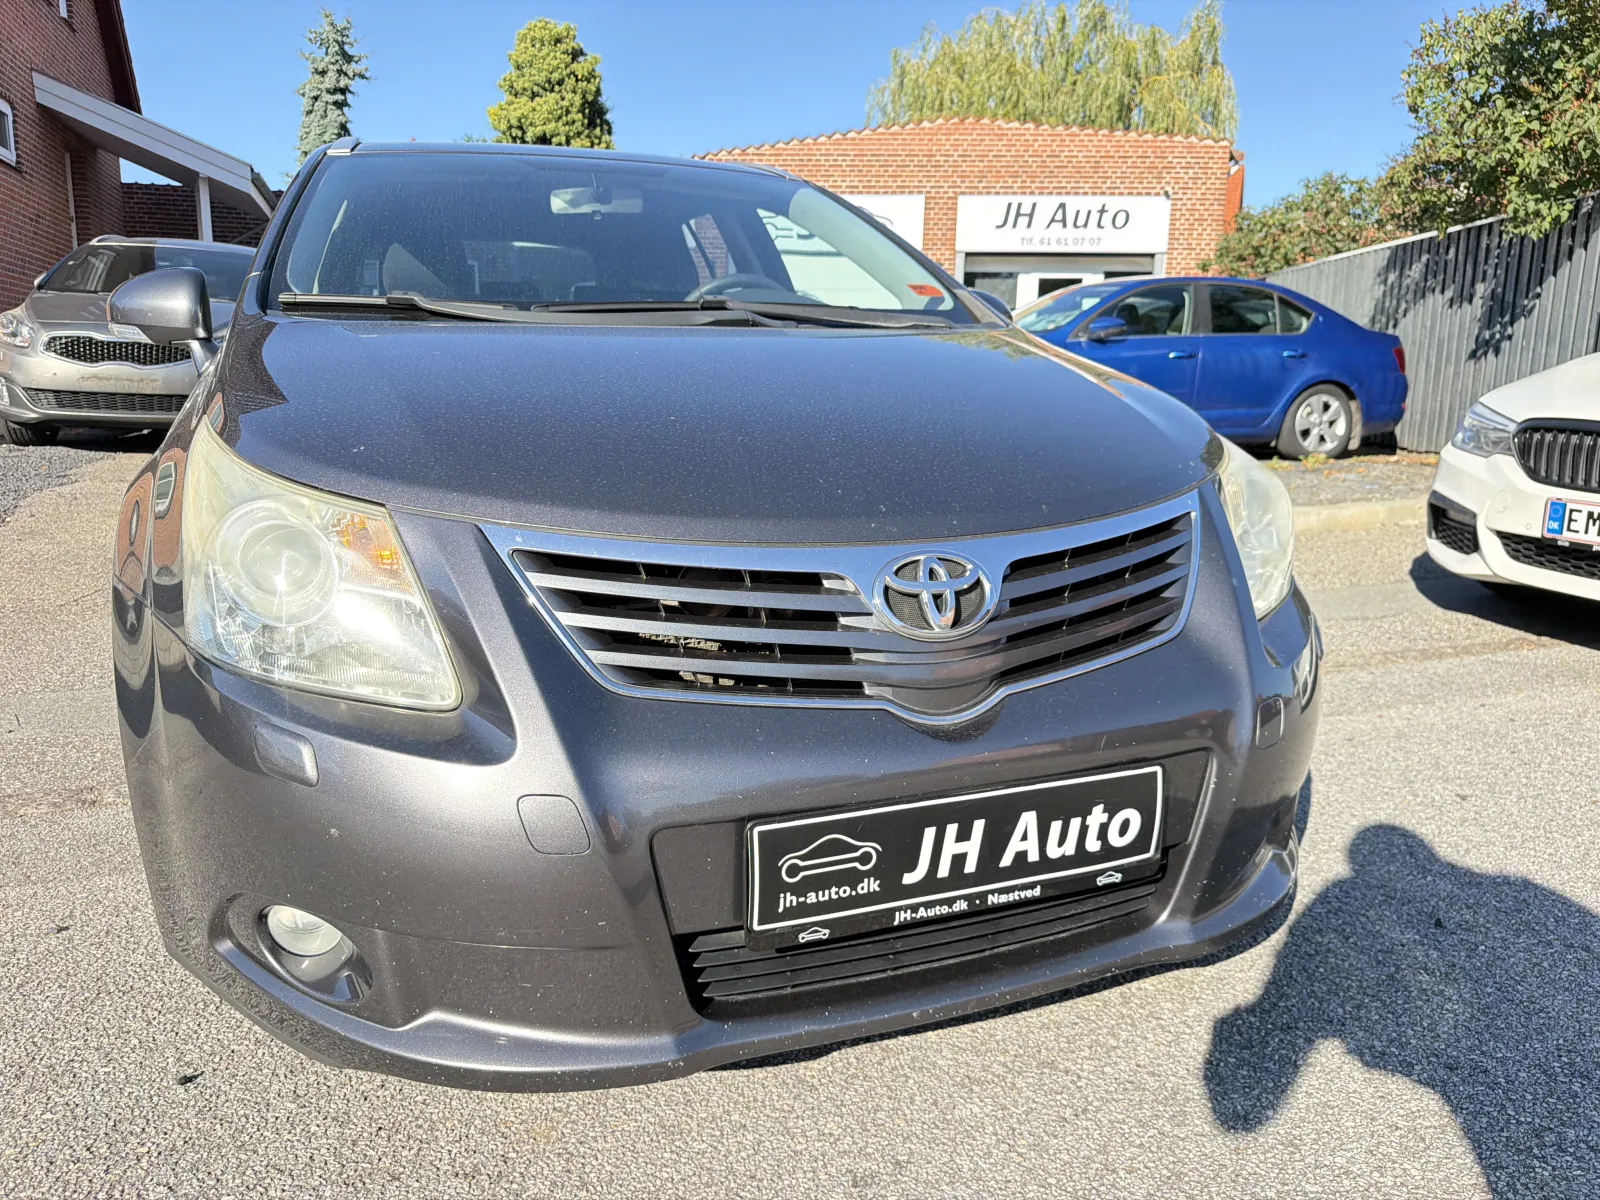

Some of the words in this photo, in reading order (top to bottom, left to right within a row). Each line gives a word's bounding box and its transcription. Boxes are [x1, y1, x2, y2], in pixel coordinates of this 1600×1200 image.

[995, 202, 1037, 230] JH
[1045, 202, 1131, 230] Auto
[1039, 236, 1051, 246] 61
[1056, 236, 1069, 246] 61
[1072, 236, 1086, 246] 07
[1088, 236, 1103, 246] 07
[1548, 520, 1560, 530] DK
[901, 818, 985, 886] JH
[999, 803, 1142, 868] Auto
[777, 876, 881, 913] jh-auto.dk
[893, 901, 969, 926] JH-Auto.dk
[987, 885, 1042, 906] Næstved
